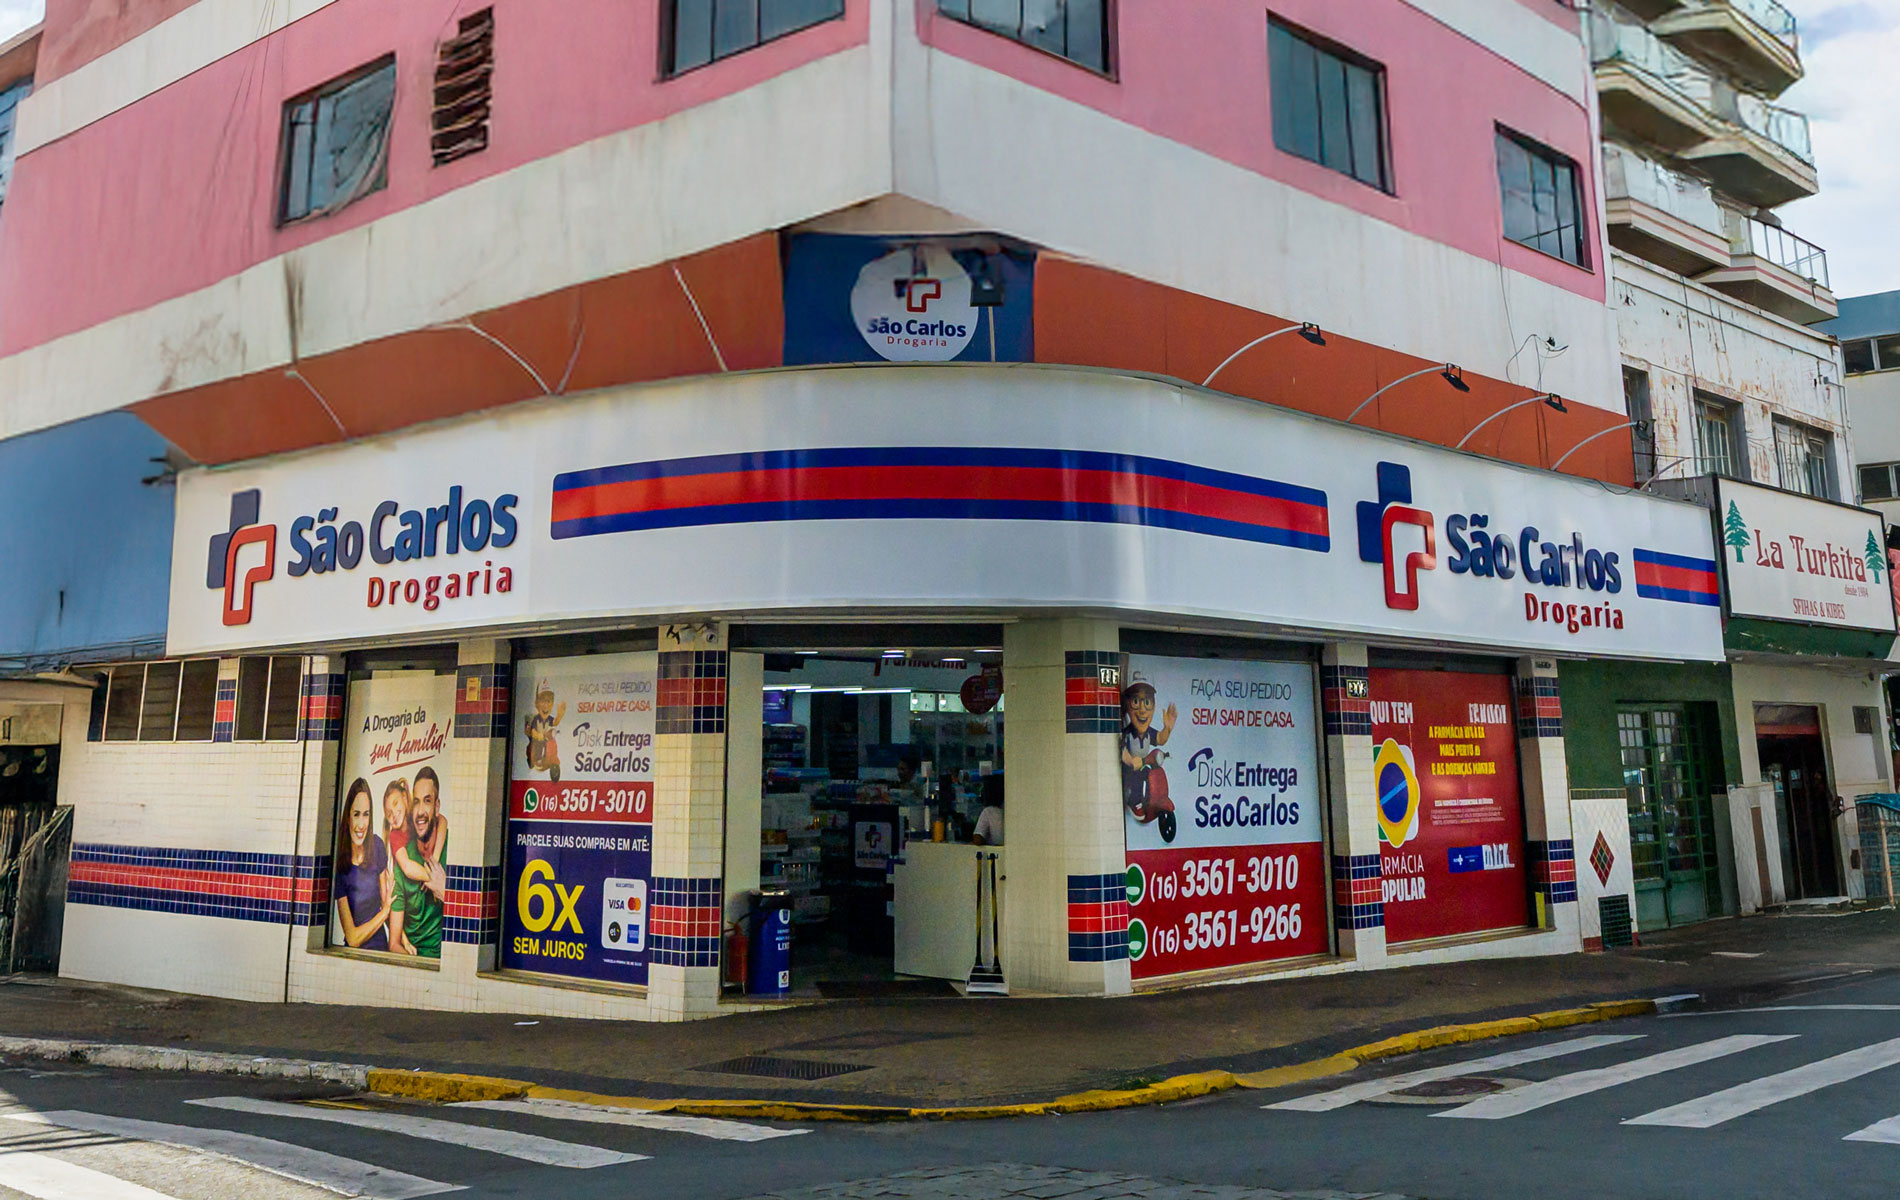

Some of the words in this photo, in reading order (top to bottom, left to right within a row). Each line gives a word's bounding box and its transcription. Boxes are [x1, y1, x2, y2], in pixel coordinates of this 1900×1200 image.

[867, 317, 902, 334] São
[905, 320, 967, 337] Carlos
[887, 336, 947, 348] Drogaria
[287, 506, 363, 577] São
[369, 485, 518, 564] Carlos
[1446, 513, 1517, 580] São
[1519, 526, 1622, 594] Carlos
[1754, 529, 1785, 570] La
[1789, 534, 1867, 583] Turkita
[367, 560, 513, 611] Drogaria
[1524, 592, 1624, 634] Drogaria
[1793, 598, 1818, 616] SFIHAS
[1820, 602, 1826, 617] &
[1826, 602, 1846, 620] KIBES
[620, 681, 652, 693] PEDIDO
[1191, 678, 1222, 701] FAÇA
[1225, 681, 1248, 699] SEU
[1250, 682, 1292, 700] PEDIDO
[577, 701, 596, 713] SEM
[596, 700, 615, 712] SAIR
[616, 700, 627, 712] DE
[1192, 708, 1218, 727] SEM
[1220, 708, 1244, 728] SAIR
[1246, 710, 1262, 728] DE
[1264, 711, 1295, 728] CASA.
[1370, 700, 1390, 726] QUI
[1391, 702, 1414, 724] TEM
[363, 716, 370, 733] A
[373, 710, 412, 732] Drogaria
[414, 706, 426, 724] da
[578, 730, 601, 747] Disk
[604, 730, 650, 751] Entrega
[370, 742, 393, 765] sua
[1197, 759, 1232, 788] Disk
[1235, 761, 1298, 793] Entrega
[540, 794, 558, 812] (16)
[560, 788, 646, 813] 3561-3010
[517, 834, 552, 846] PARCELE
[552, 836, 574, 848] SUAS
[576, 836, 616, 850] COMPRAS
[618, 838, 630, 850] EM
[1151, 871, 1178, 902] (16)
[1181, 854, 1299, 898] 3561-3010
[1382, 876, 1426, 903] OPULAR
[518, 858, 584, 934] 6x
[608, 899, 624, 910] VISA
[1152, 924, 1180, 957] (16)
[1183, 903, 1302, 952] 3561-9266
[514, 937, 538, 956] SEM
